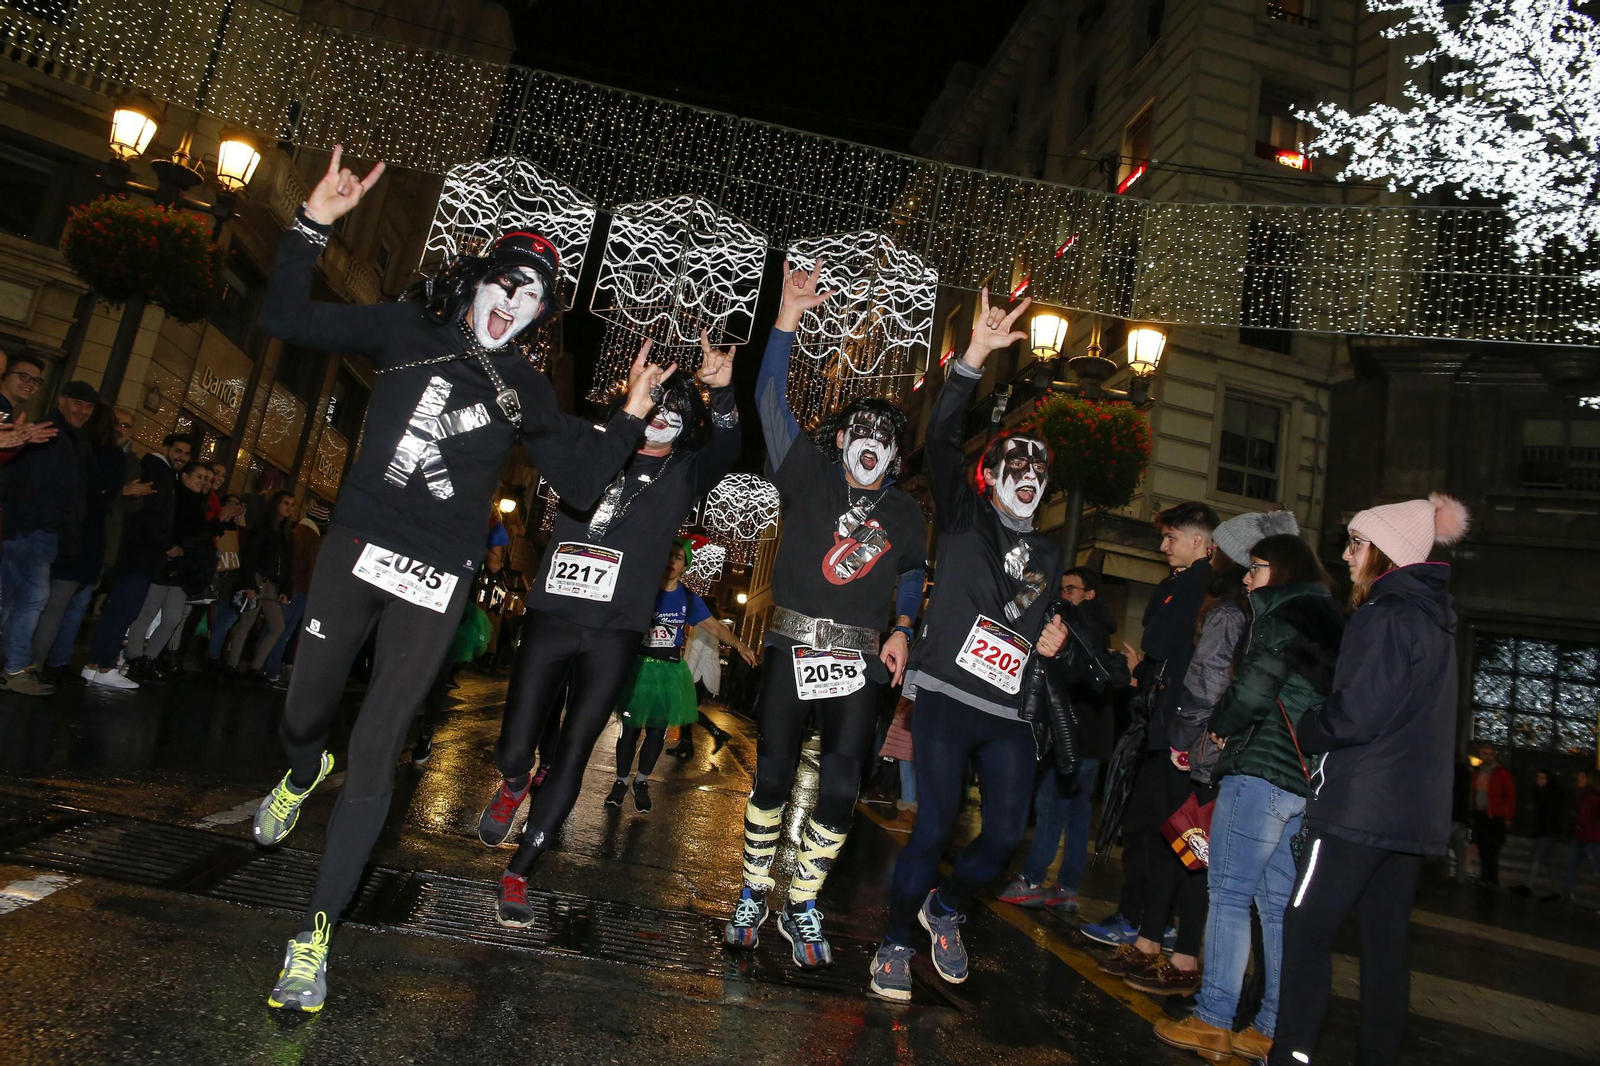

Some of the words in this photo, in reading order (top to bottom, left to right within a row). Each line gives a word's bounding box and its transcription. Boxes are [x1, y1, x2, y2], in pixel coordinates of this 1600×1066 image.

[383, 376, 491, 500] K
[374, 553, 442, 590] 2045
[555, 561, 608, 585] 2217
[803, 663, 858, 684] 2058
[971, 639, 1021, 678] 2202
